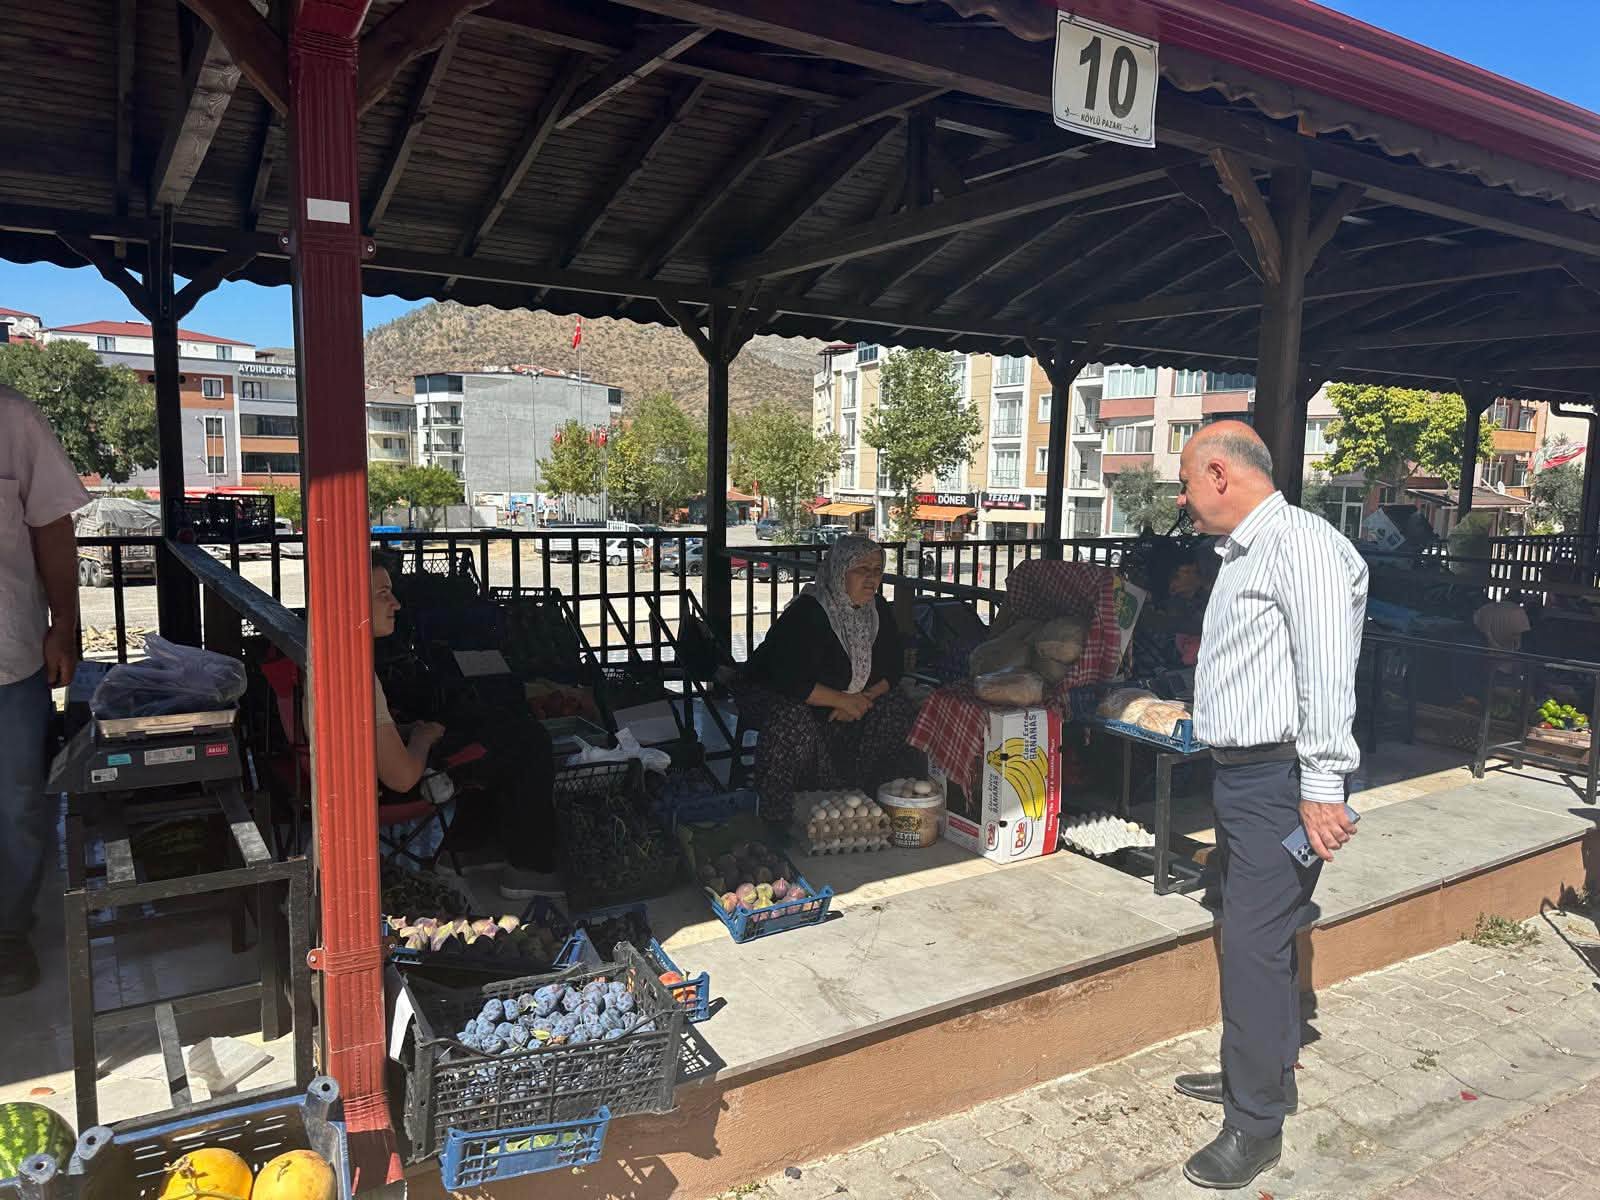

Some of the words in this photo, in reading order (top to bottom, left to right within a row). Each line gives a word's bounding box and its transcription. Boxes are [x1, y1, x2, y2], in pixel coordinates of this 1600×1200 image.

[1080, 36, 1138, 119] 10
[1081, 112, 1101, 125] KÖYLÜ
[1102, 119, 1122, 130] PAZARI
[938, 494, 967, 505] DÖNER
[988, 493, 1020, 503] TEZGAH
[1029, 714, 1037, 760] BANANAS
[1015, 822, 1025, 848] Dole
